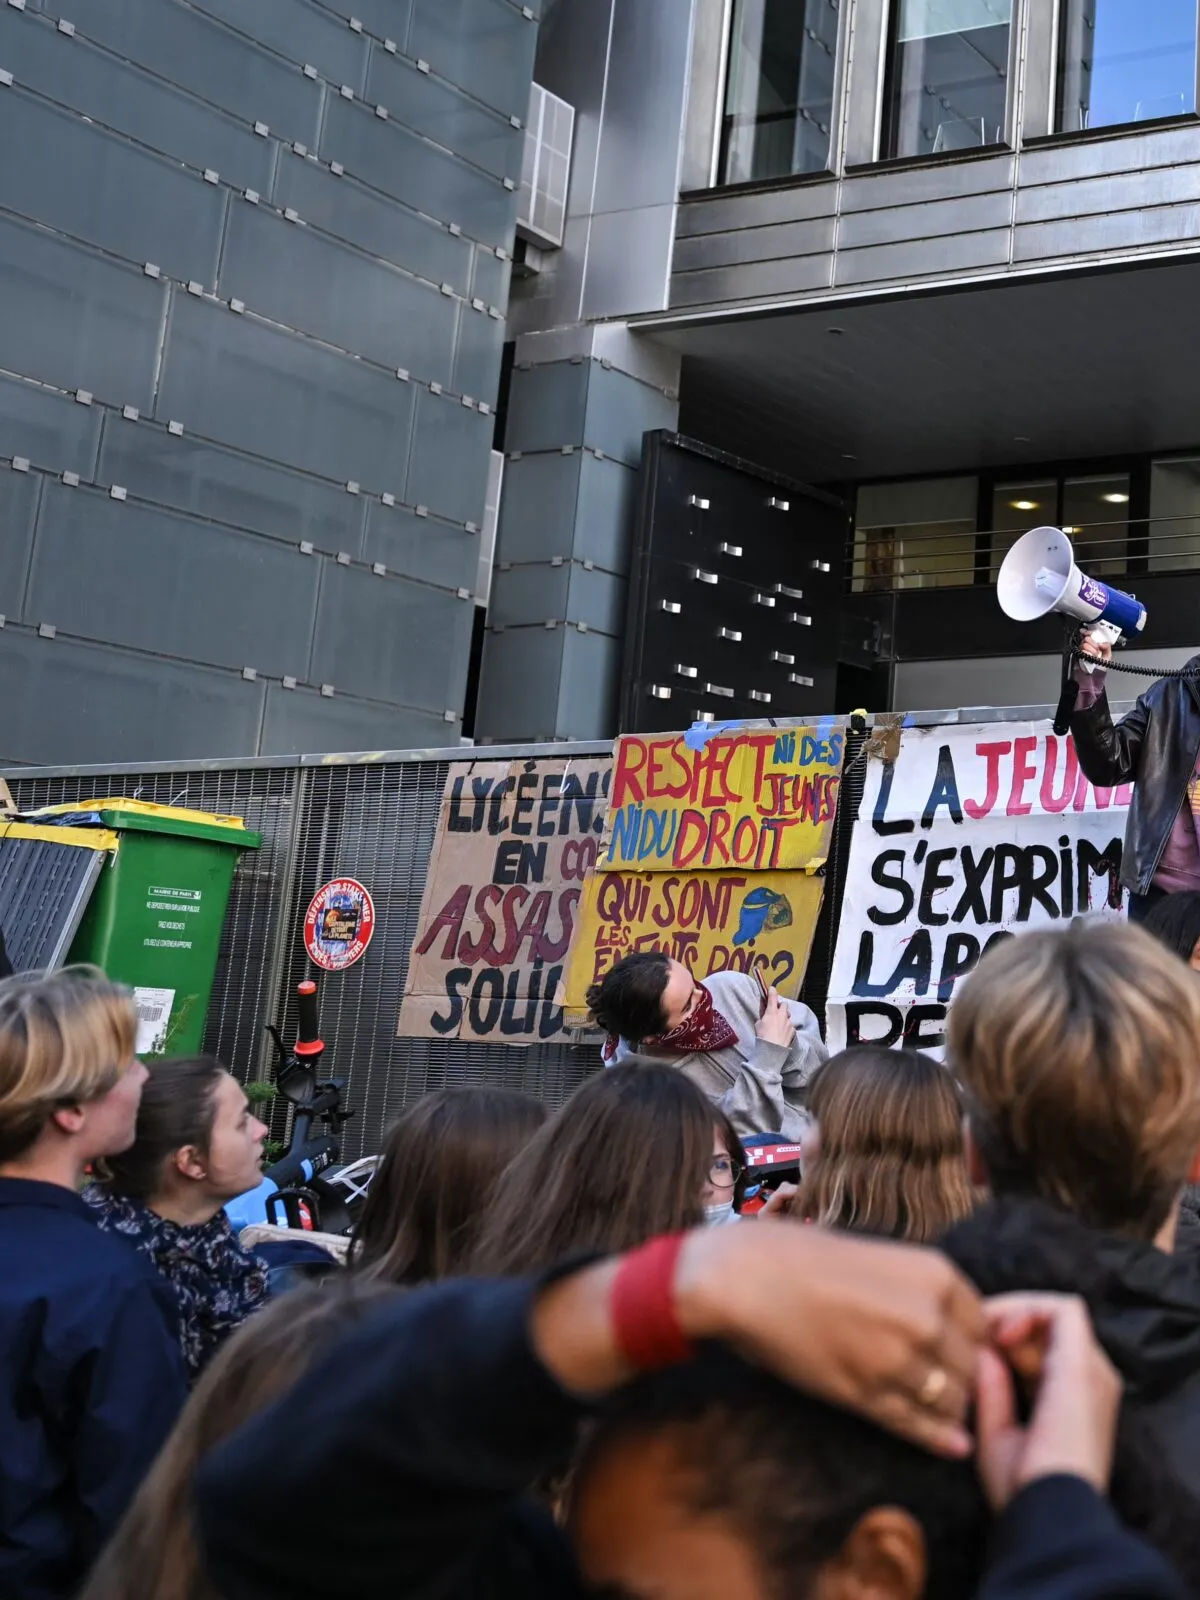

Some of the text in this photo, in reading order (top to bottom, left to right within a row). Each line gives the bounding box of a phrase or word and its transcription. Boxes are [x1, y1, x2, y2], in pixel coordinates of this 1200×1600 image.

[611, 734, 777, 809] RESPECT
[799, 734, 842, 767] DES
[756, 773, 840, 826] JEUNES
[872, 744, 964, 836] LA
[492, 838, 601, 885] EN CO
[639, 808, 677, 862] DU
[415, 884, 582, 967] ASSAS
[652, 876, 747, 932] SONT
[594, 924, 632, 948] LES
[851, 928, 933, 998] LA
